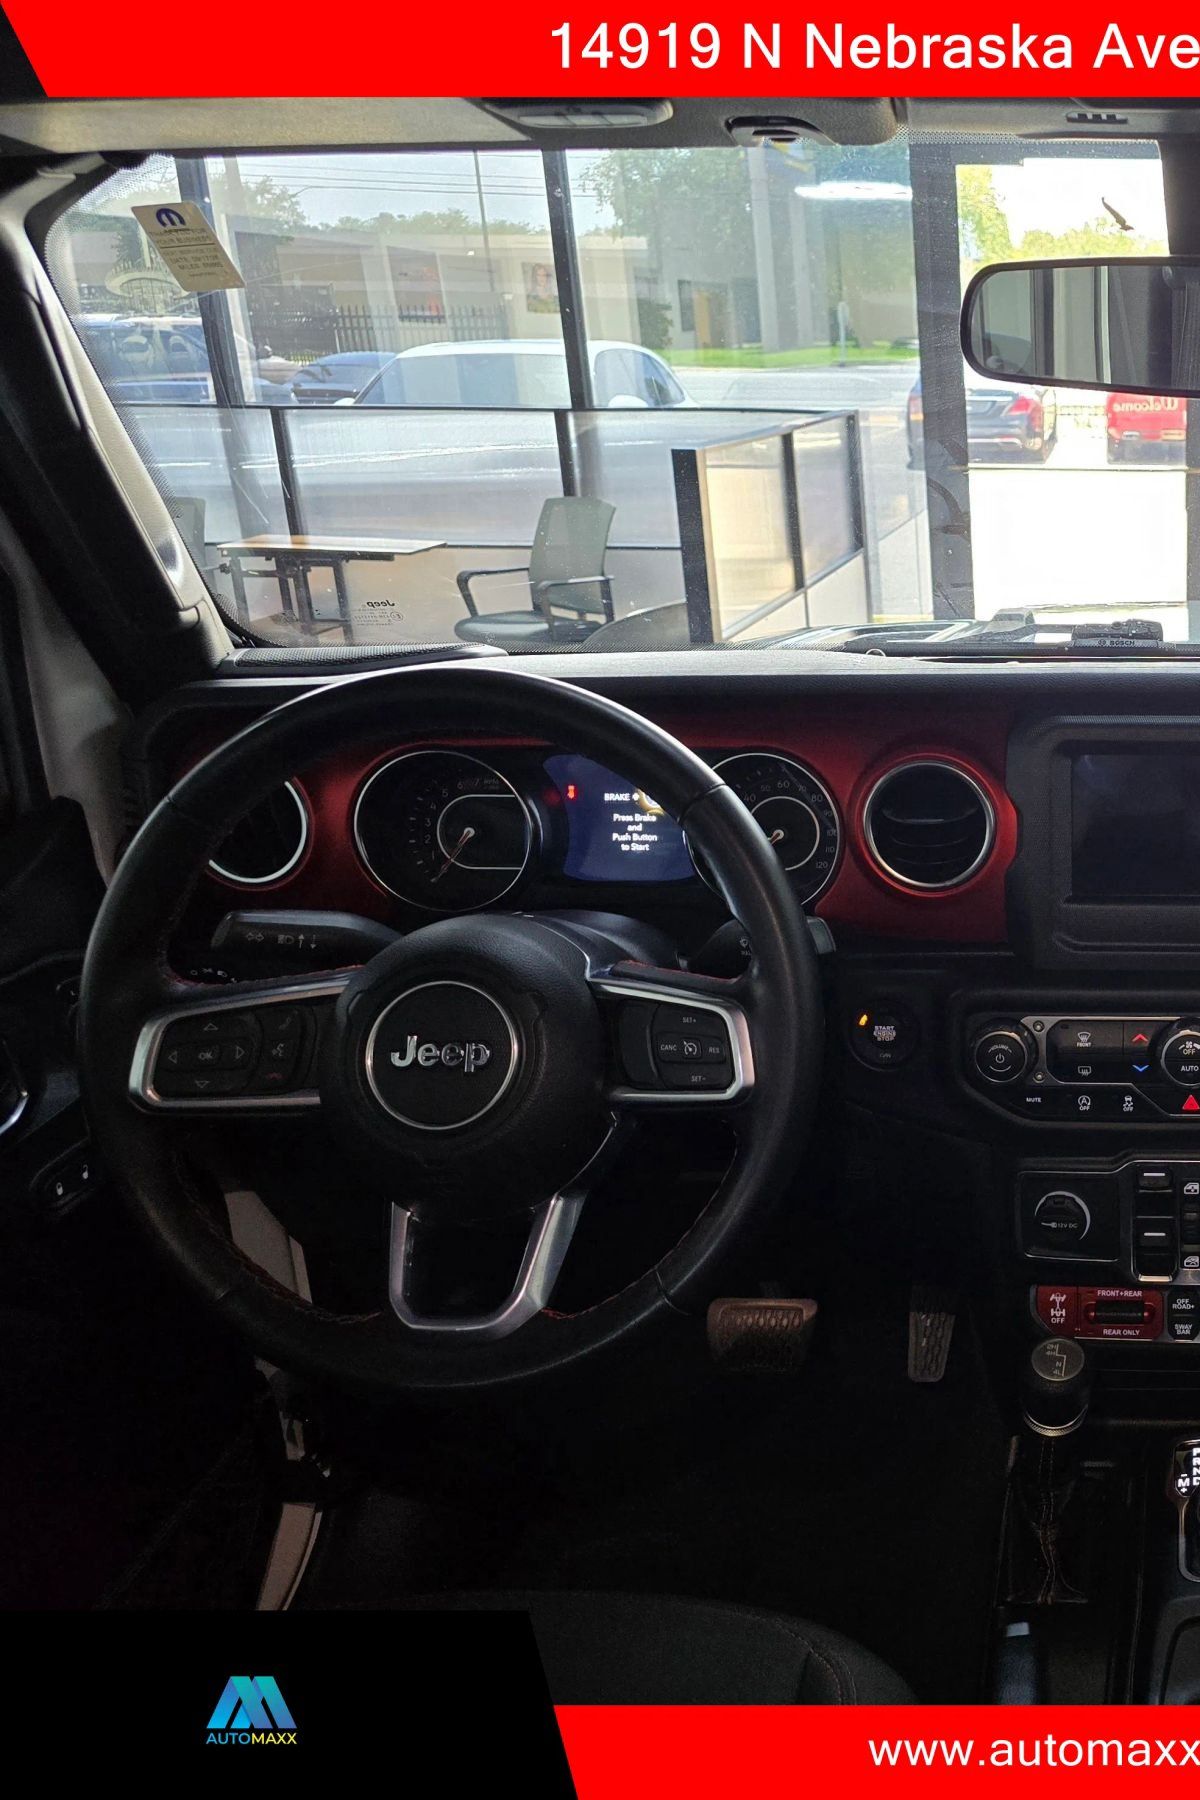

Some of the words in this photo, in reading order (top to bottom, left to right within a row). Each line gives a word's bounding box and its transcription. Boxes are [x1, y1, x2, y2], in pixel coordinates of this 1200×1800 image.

[604, 793, 631, 801] BRAKE
[613, 813, 634, 822] Press
[634, 813, 657, 822] Brake
[627, 823, 643, 831] and
[612, 833, 631, 841] Push
[632, 833, 658, 841] Button
[621, 843, 630, 851] to
[631, 843, 650, 851] Start
[390, 1035, 491, 1073] Jeep
[1177, 1477, 1190, 1487] M
